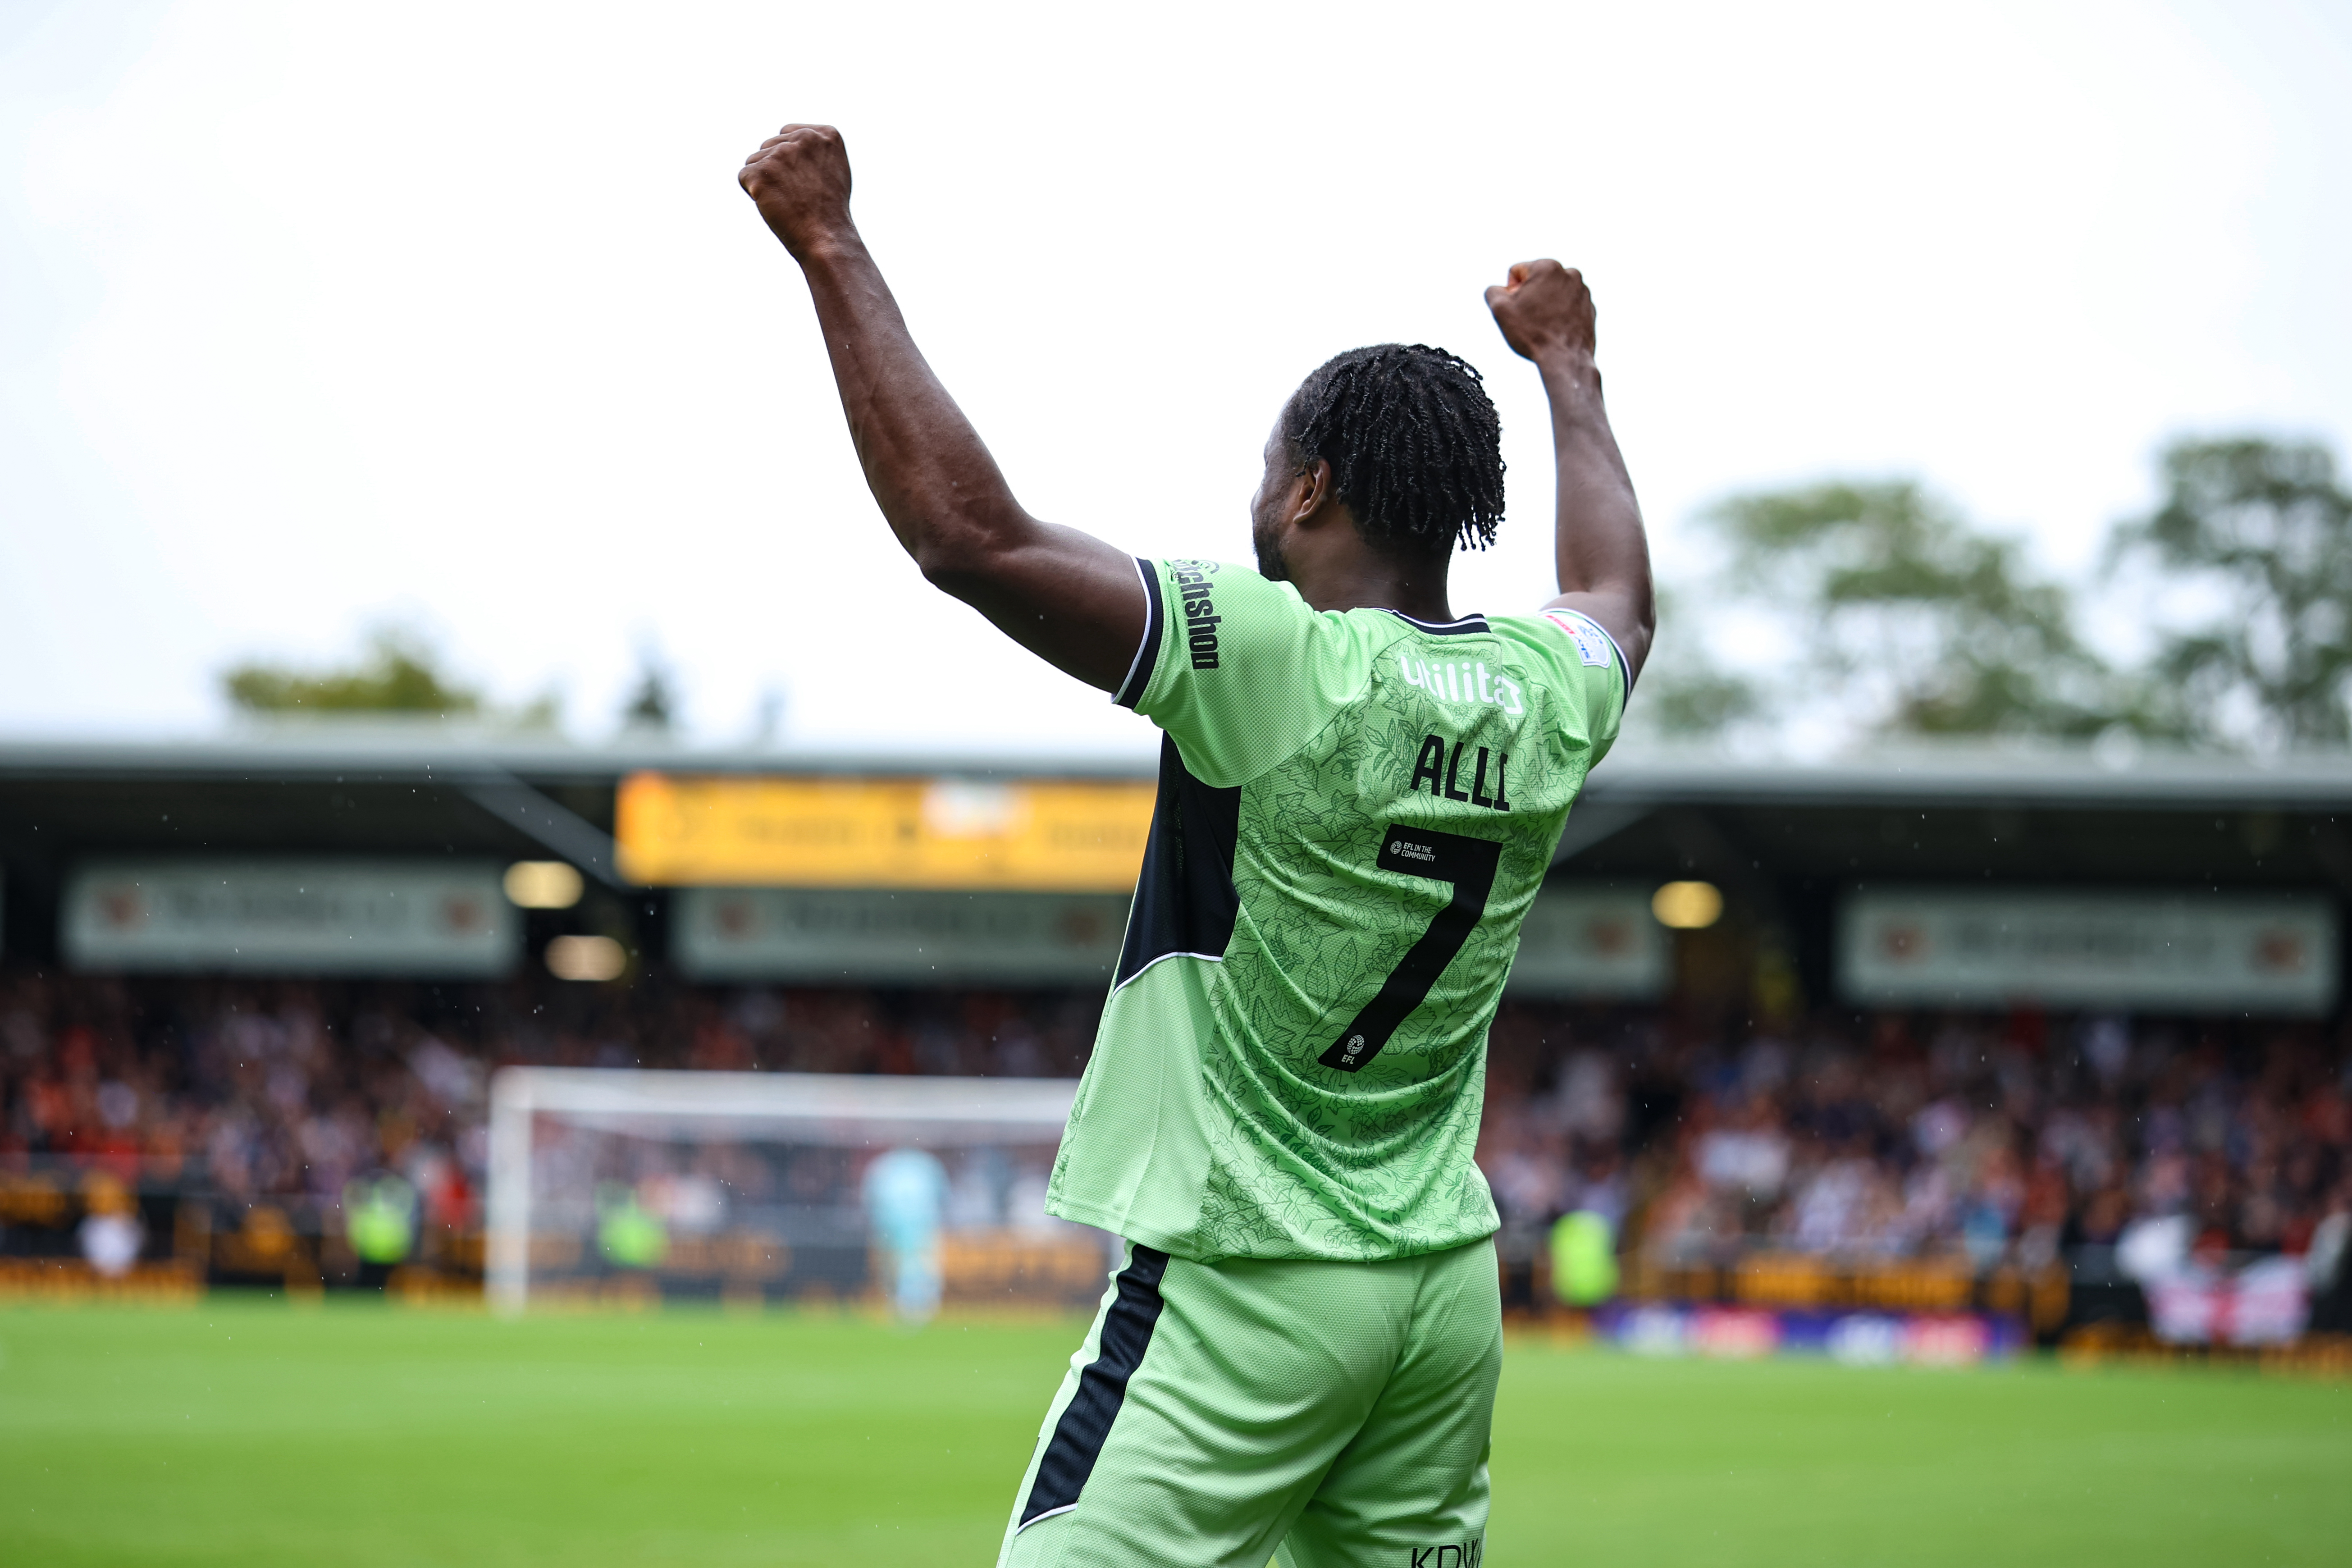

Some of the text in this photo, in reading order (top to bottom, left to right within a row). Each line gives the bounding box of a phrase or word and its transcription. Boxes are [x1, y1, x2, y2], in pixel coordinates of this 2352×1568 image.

[1400, 655, 1523, 715] utilita
[1410, 734, 1510, 812] ALLI
[1402, 850, 1435, 862] COMMUNITY
[1318, 823, 1503, 1073] 7
[1341, 1054, 1355, 1065] EFL
[1411, 1538, 1482, 1568] KDW
